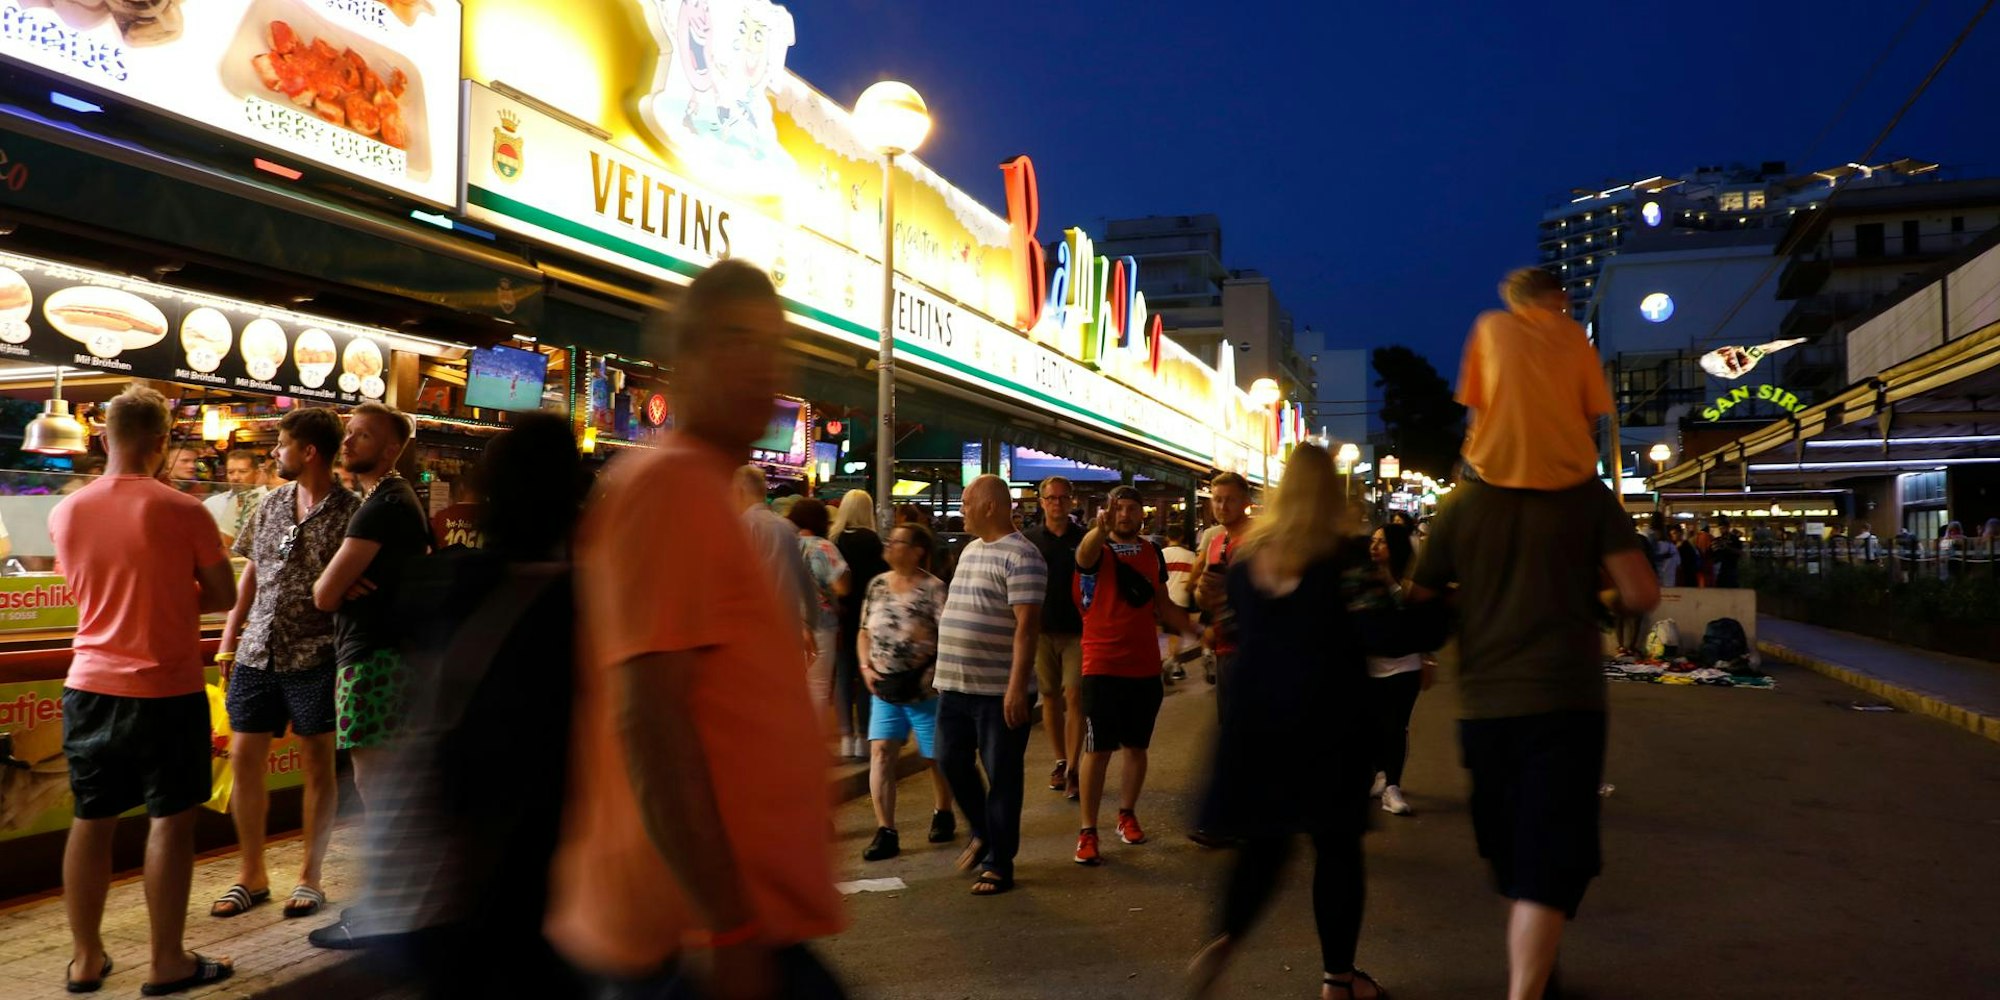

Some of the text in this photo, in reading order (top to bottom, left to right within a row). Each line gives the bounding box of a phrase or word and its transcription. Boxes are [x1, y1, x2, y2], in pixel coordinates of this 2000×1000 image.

[589, 150, 732, 261] VELTINS
[74, 353, 132, 371] Mit Brötchen
[175, 368, 227, 385] Mit Brötchen
[235, 377, 283, 392] Mit Brötchen
[1702, 385, 1750, 422] SAN
